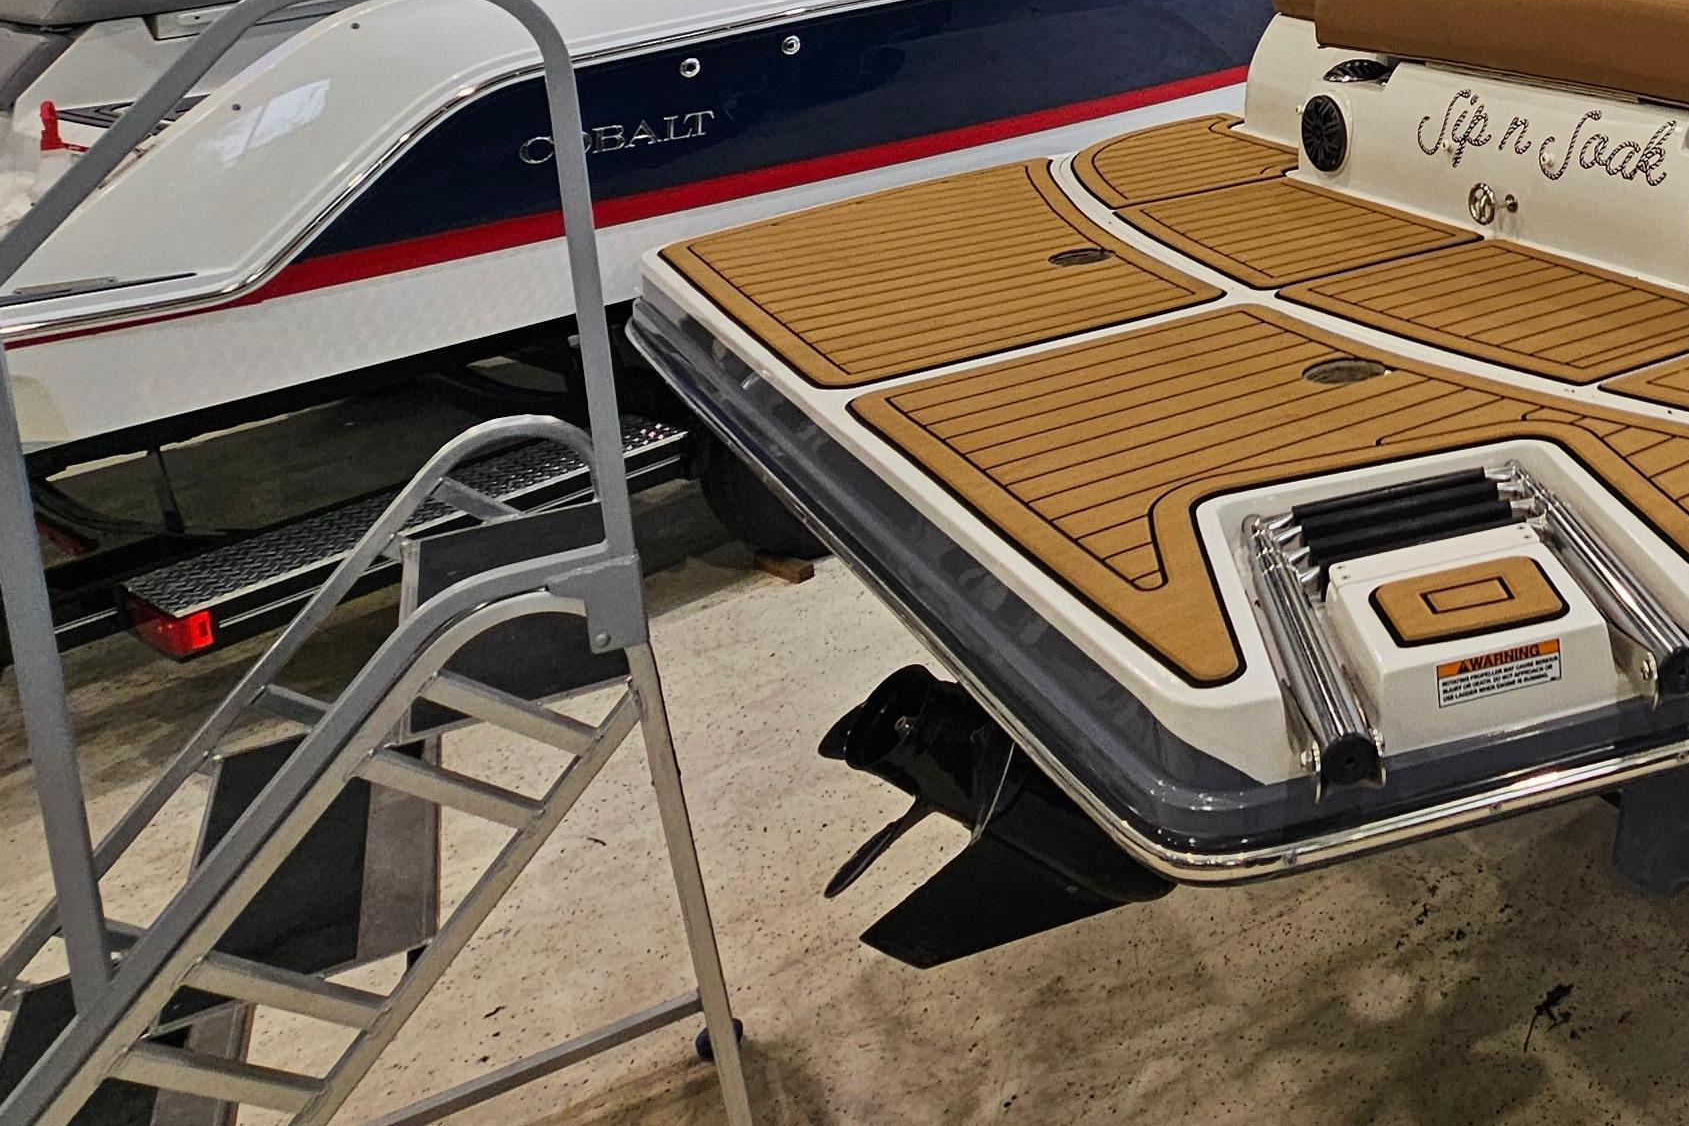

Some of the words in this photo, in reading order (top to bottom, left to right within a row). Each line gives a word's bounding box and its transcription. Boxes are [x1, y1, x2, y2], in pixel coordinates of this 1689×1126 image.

[1418, 89, 1491, 167] Sip
[1499, 117, 1531, 155] n
[1538, 110, 1677, 186] Soak
[1469, 644, 1540, 672] WARNING
